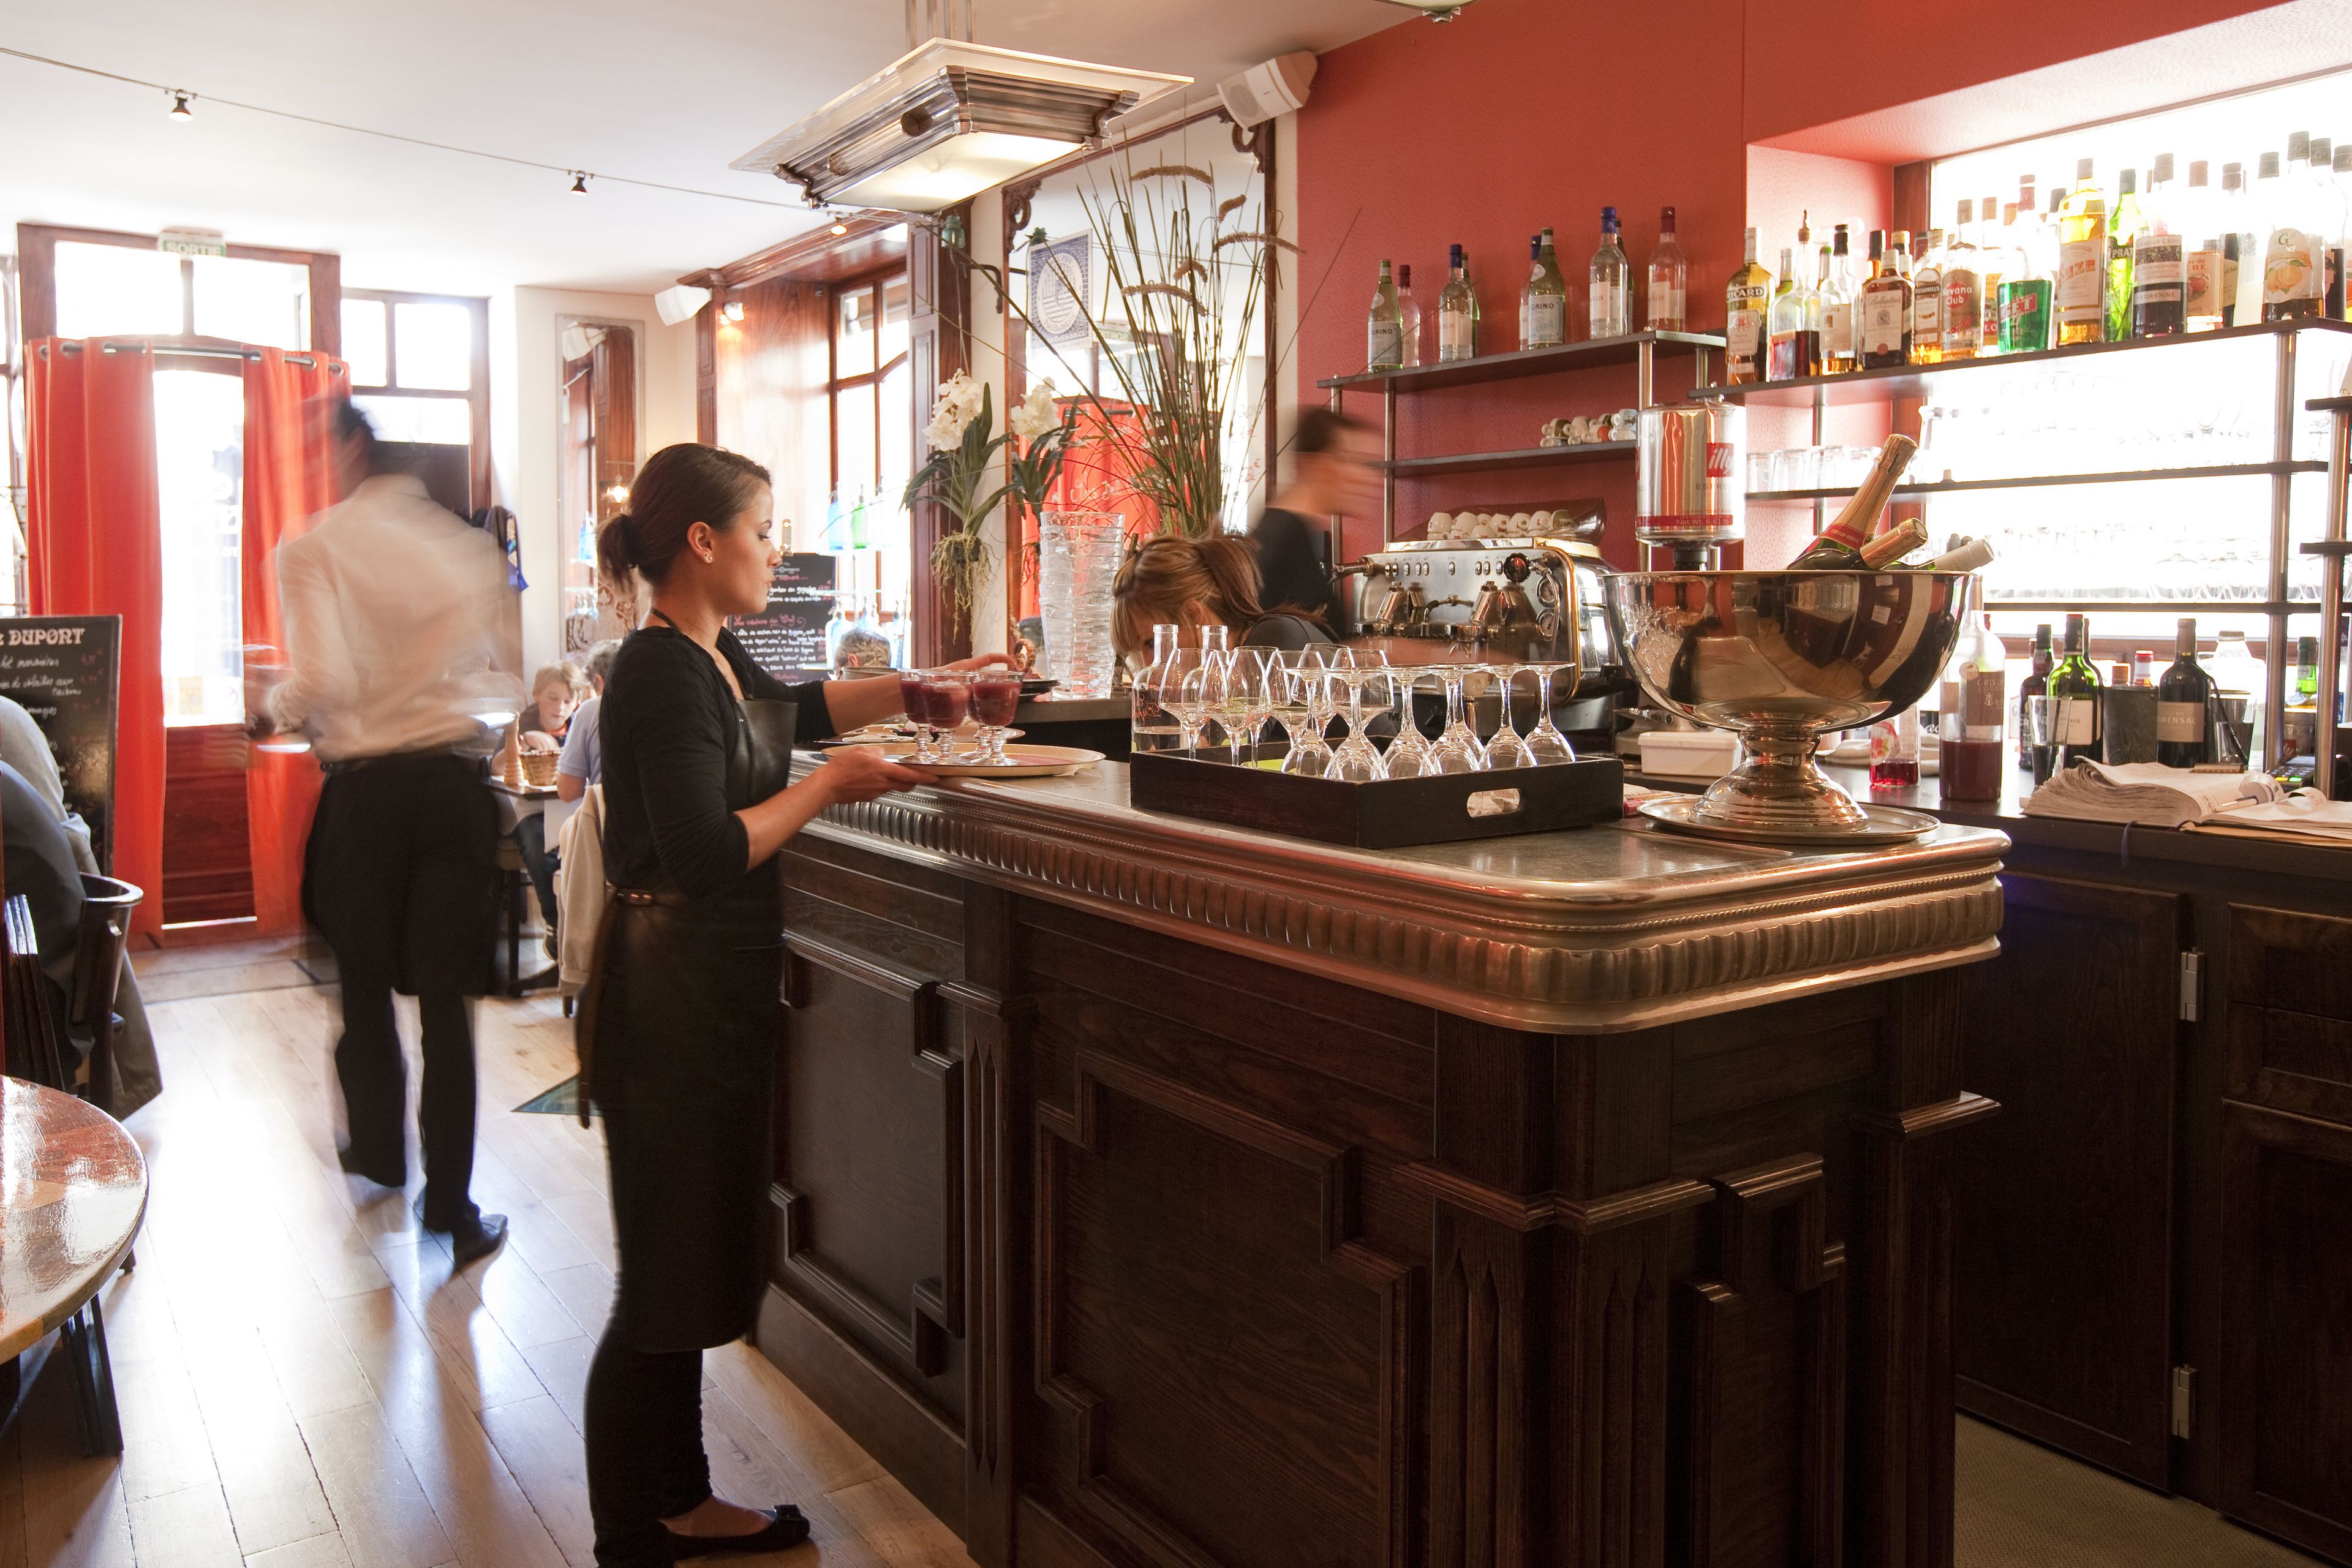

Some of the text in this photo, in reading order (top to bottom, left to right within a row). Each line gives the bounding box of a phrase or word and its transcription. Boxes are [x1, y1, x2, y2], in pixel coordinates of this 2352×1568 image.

[2277, 233, 2290, 246] G
[1726, 287, 1764, 301] RICARD
[1945, 295, 1964, 306] Club
[1708, 448, 1732, 475] illy
